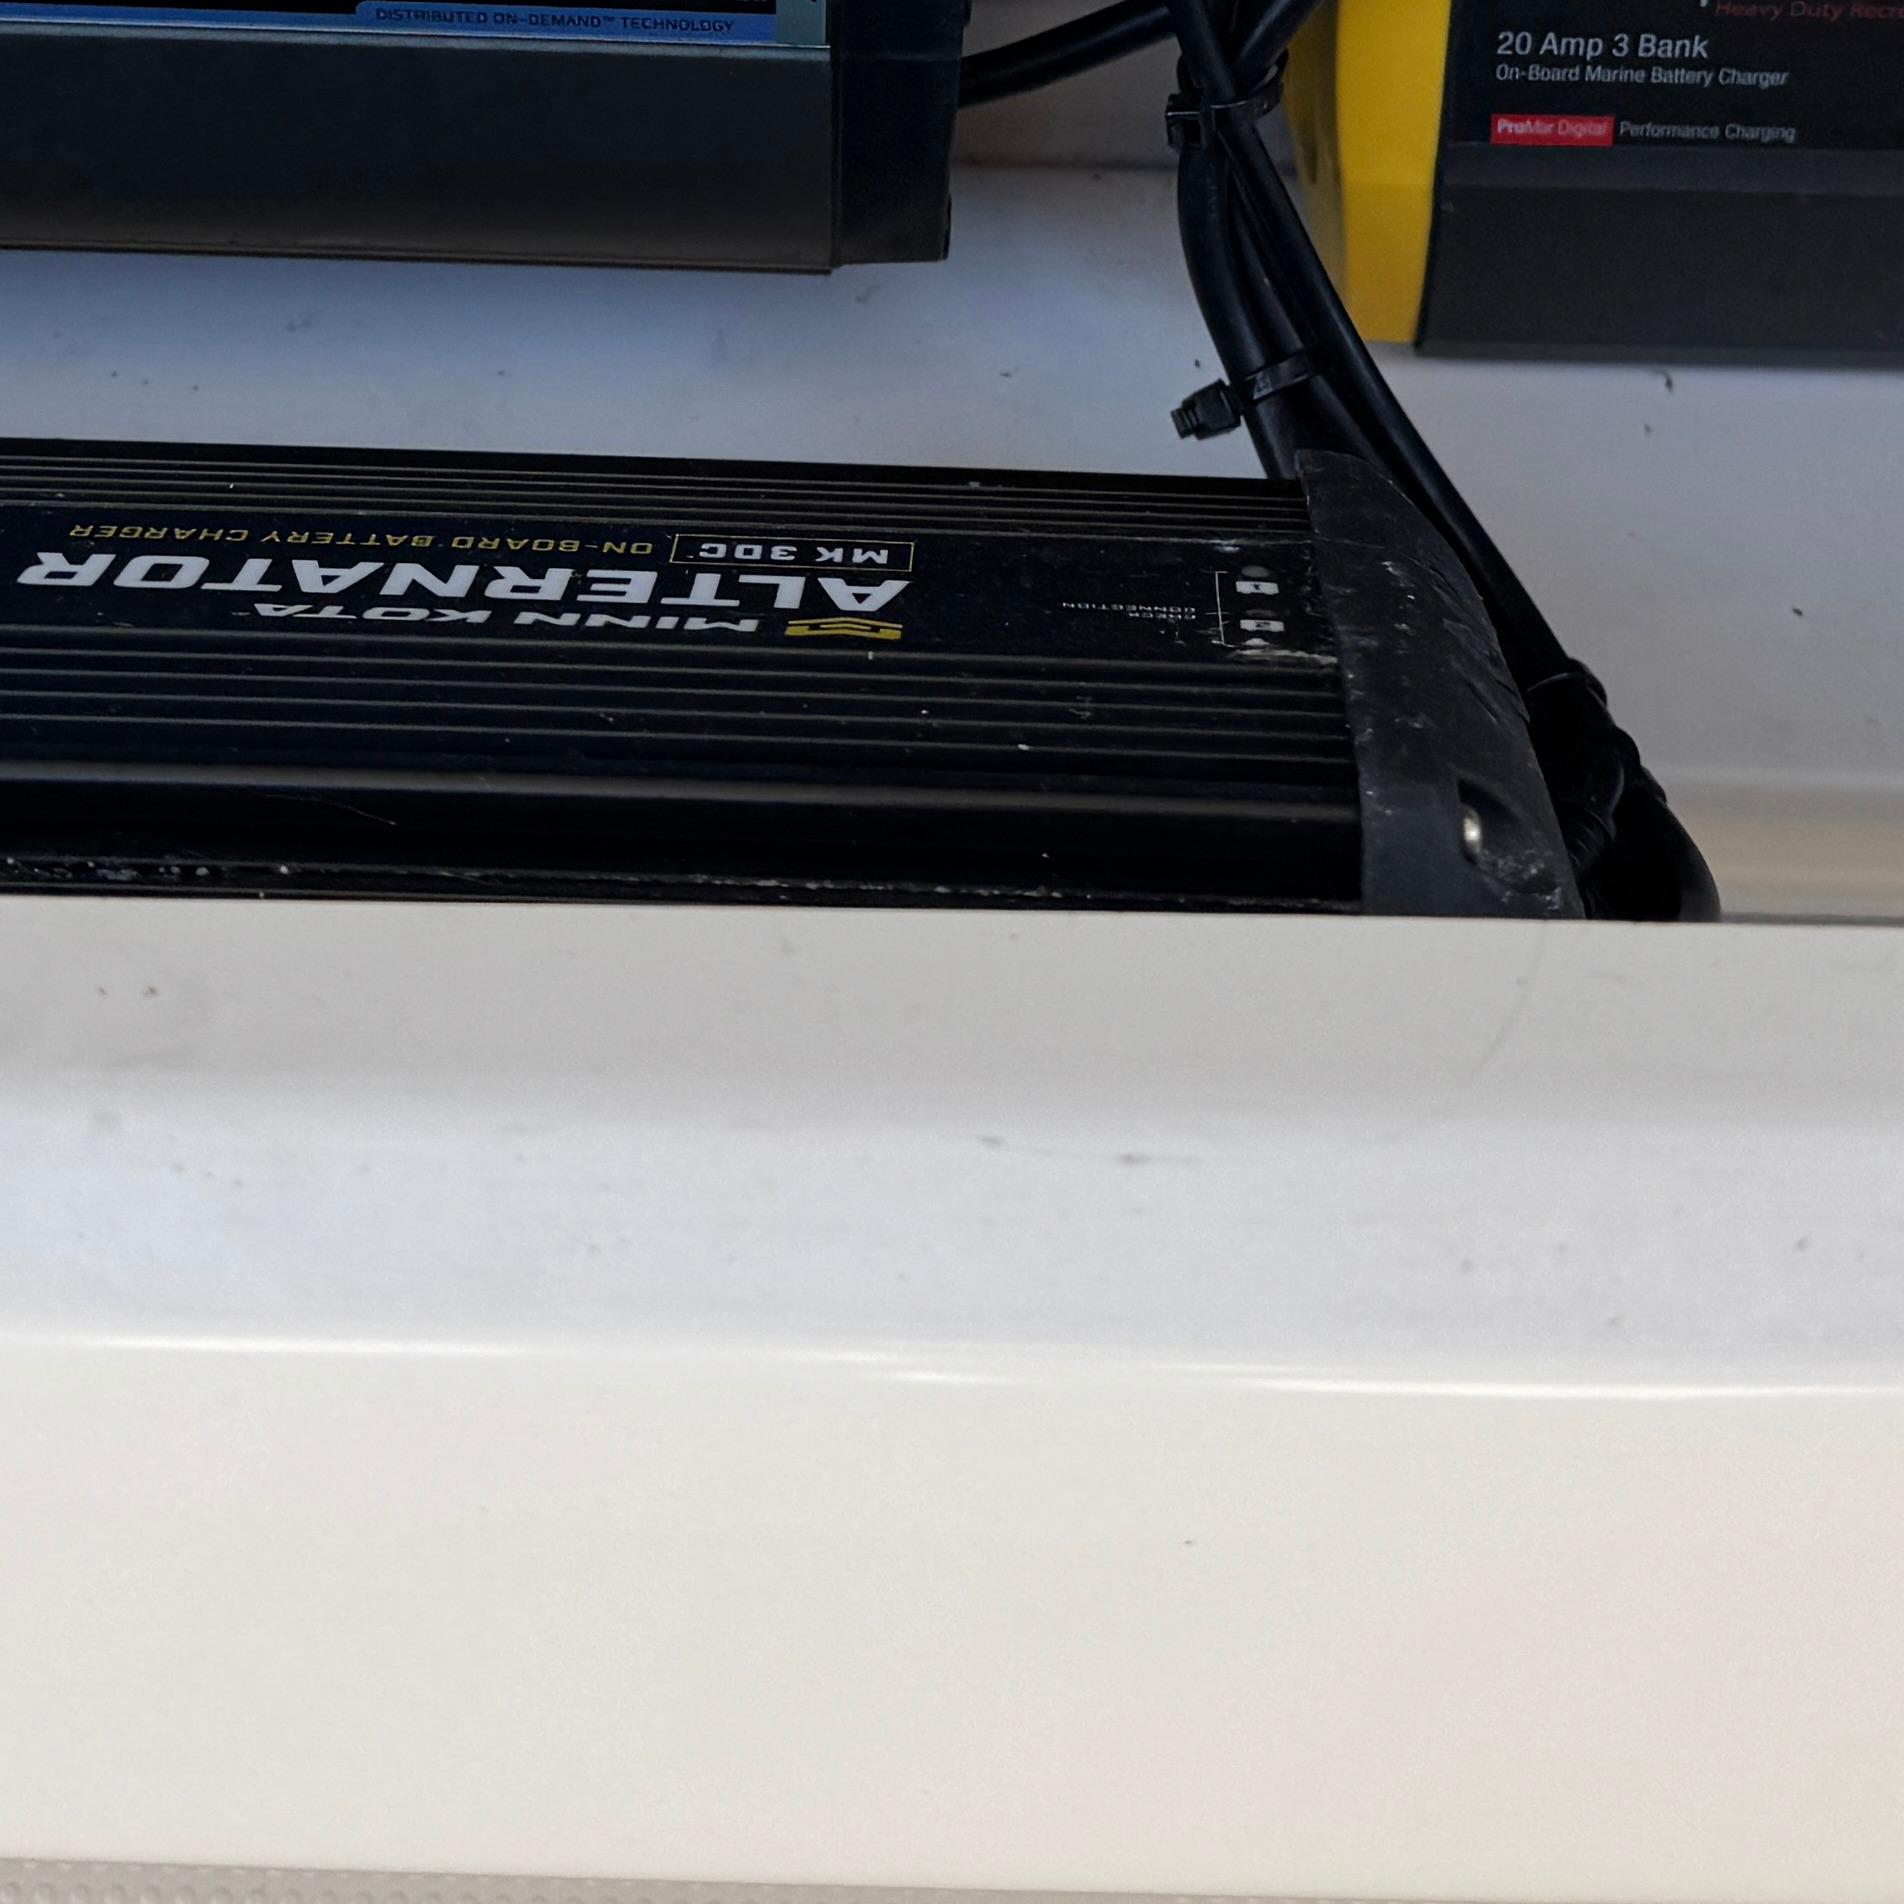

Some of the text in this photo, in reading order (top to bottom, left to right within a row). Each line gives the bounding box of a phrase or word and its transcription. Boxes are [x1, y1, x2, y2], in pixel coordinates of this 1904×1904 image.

[375, 7, 488, 25] DISTRIBUTED
[621, 15, 734, 33] TECHNOLOGY
[1715, 1, 1783, 19] Heavy
[1790, 2, 1843, 22] Duty
[1497, 31, 1710, 61] 20 Amp 3 Bank
[1495, 64, 1790, 89] On-Board Marine Battery Charger
[1557, 119, 1608, 138] Digital
[1620, 121, 1720, 139] Performance
[1725, 123, 1796, 144] Charging
[69, 524, 653, 556] ON-BOARD BATTERY CHARGER
[700, 543, 889, 564] MK 3DC
[16, 551, 912, 612] ALTERNATOR
[253, 603, 760, 633] MINN KOTA
